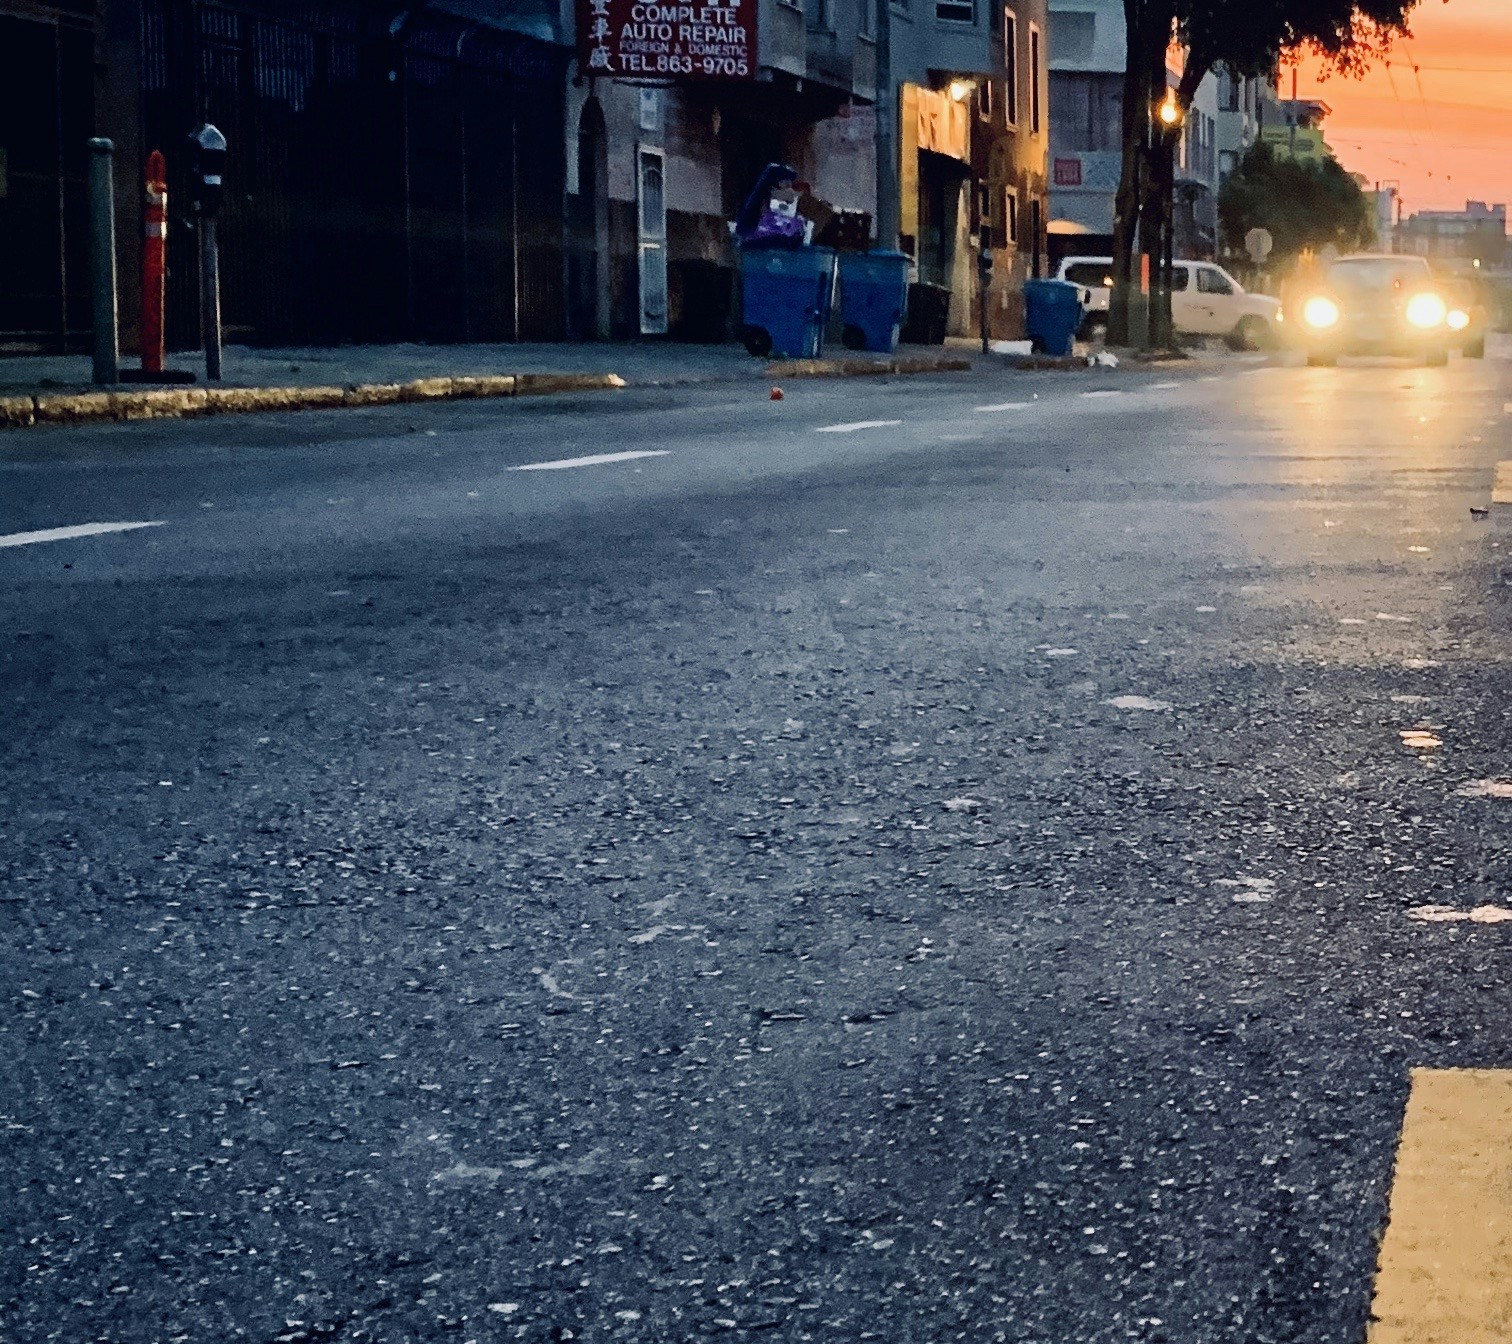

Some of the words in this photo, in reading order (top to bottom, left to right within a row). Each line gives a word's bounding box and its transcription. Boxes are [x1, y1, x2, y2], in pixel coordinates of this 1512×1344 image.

[631, 4, 737, 25] COMPLETE
[621, 23, 673, 41] AUTO
[679, 25, 746, 44] REPAIR
[619, 40, 669, 54] FOREIGN
[688, 43, 748, 57] DOMESTIC
